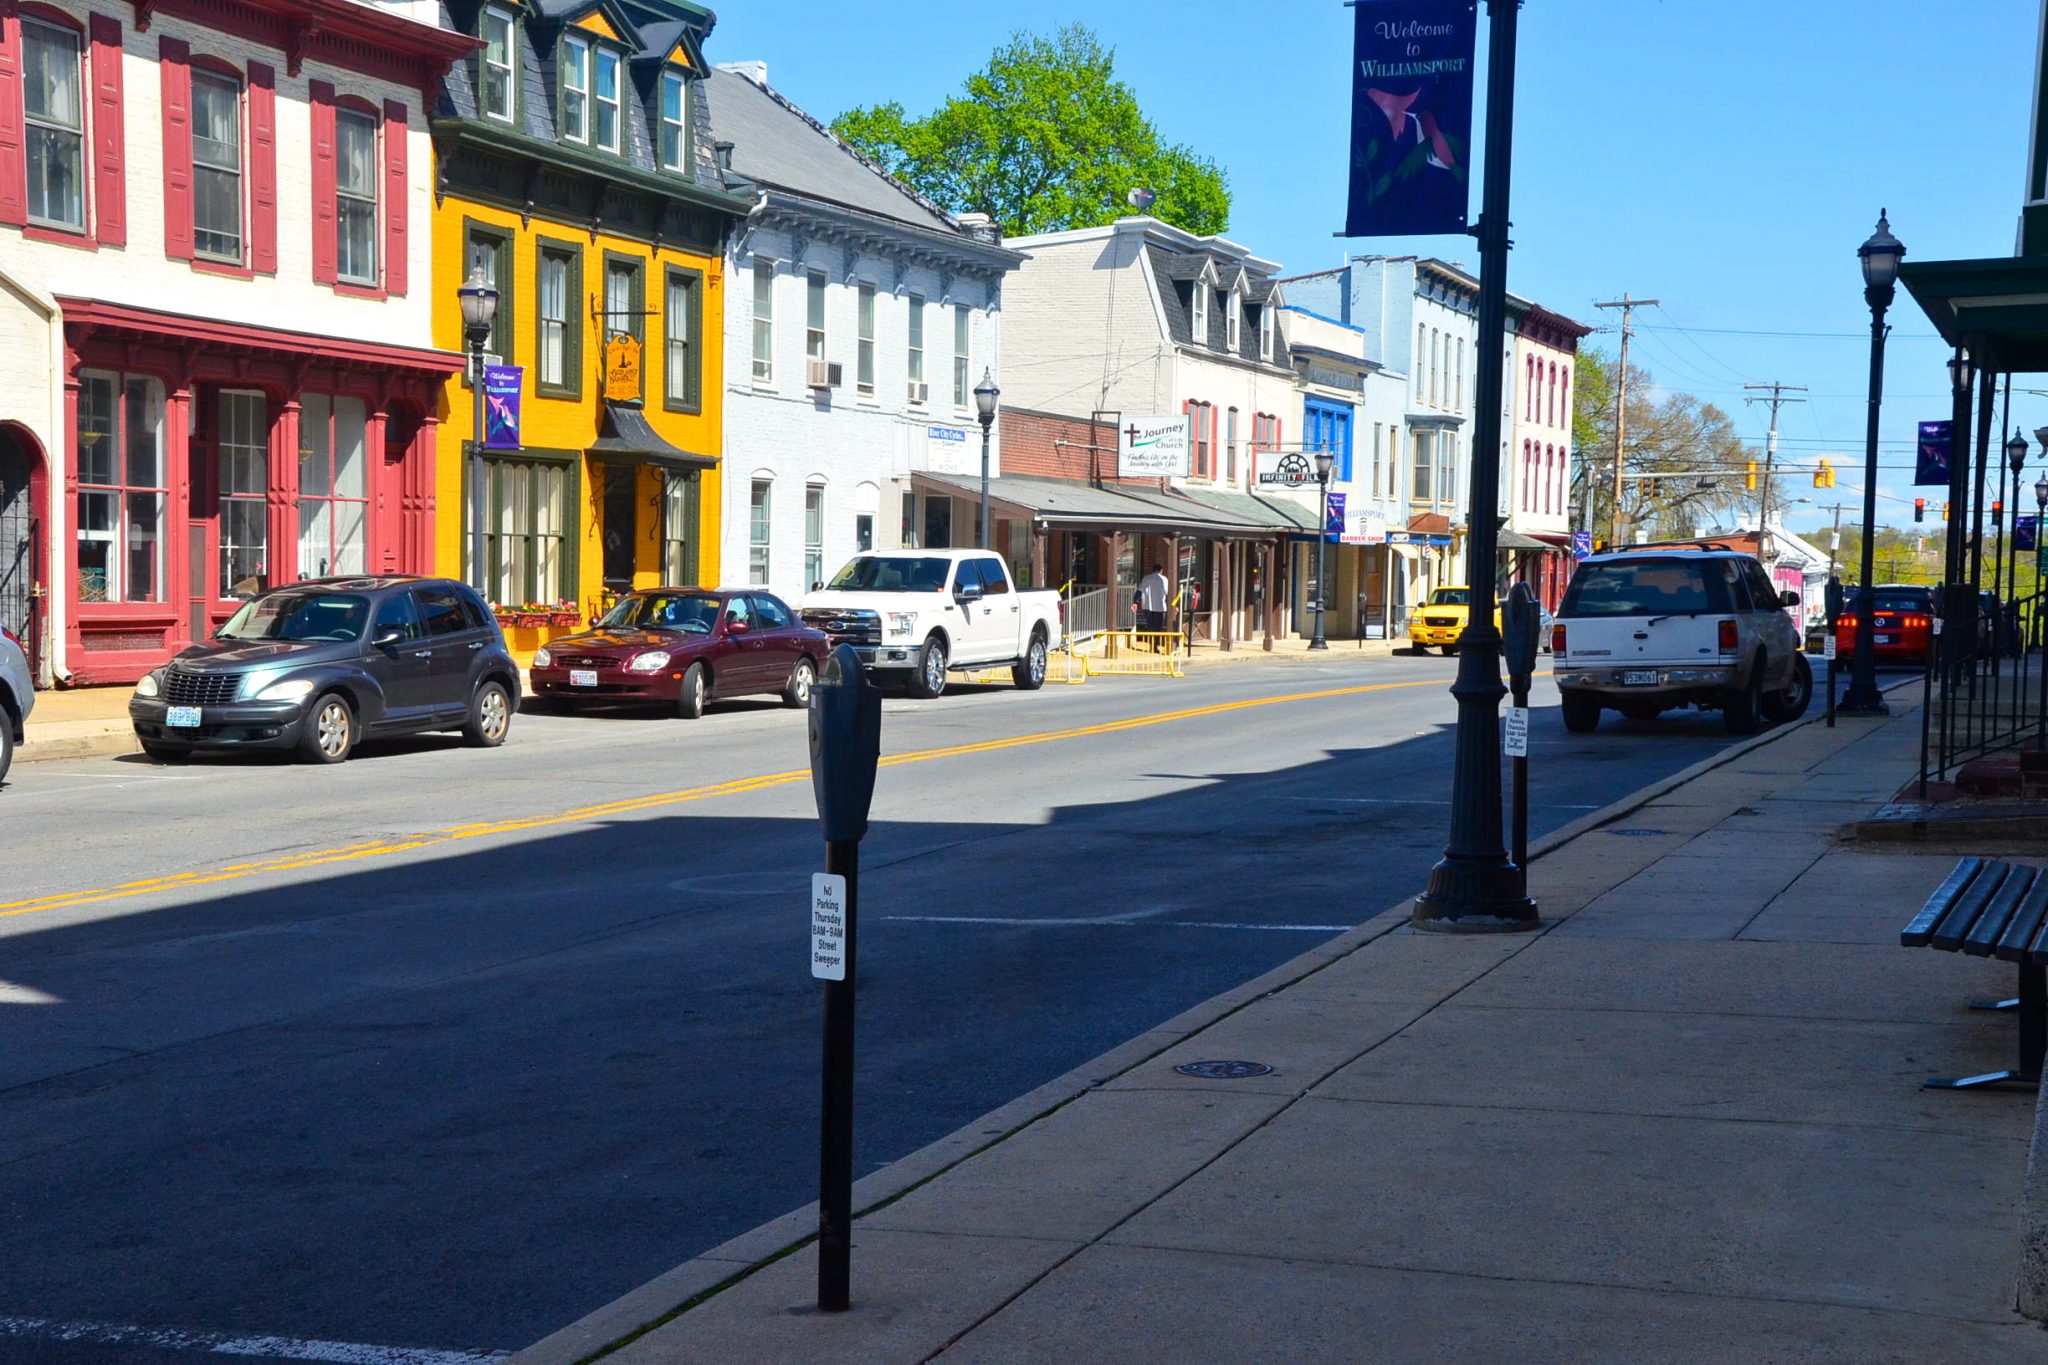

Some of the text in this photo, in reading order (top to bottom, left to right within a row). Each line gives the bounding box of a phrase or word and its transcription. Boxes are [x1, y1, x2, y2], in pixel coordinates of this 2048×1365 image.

[1375, 20, 1454, 40] Welcome
[1406, 42, 1421, 57] to
[1360, 58, 1466, 78] WILLIAMSPORT
[1144, 423, 1185, 439] Journey
[1262, 473, 1296, 481] INFINITY
[816, 898, 839, 912] Parking
[814, 911, 841, 926] Thursday
[818, 939, 837, 952] Street
[814, 952, 841, 966] Sweeper
